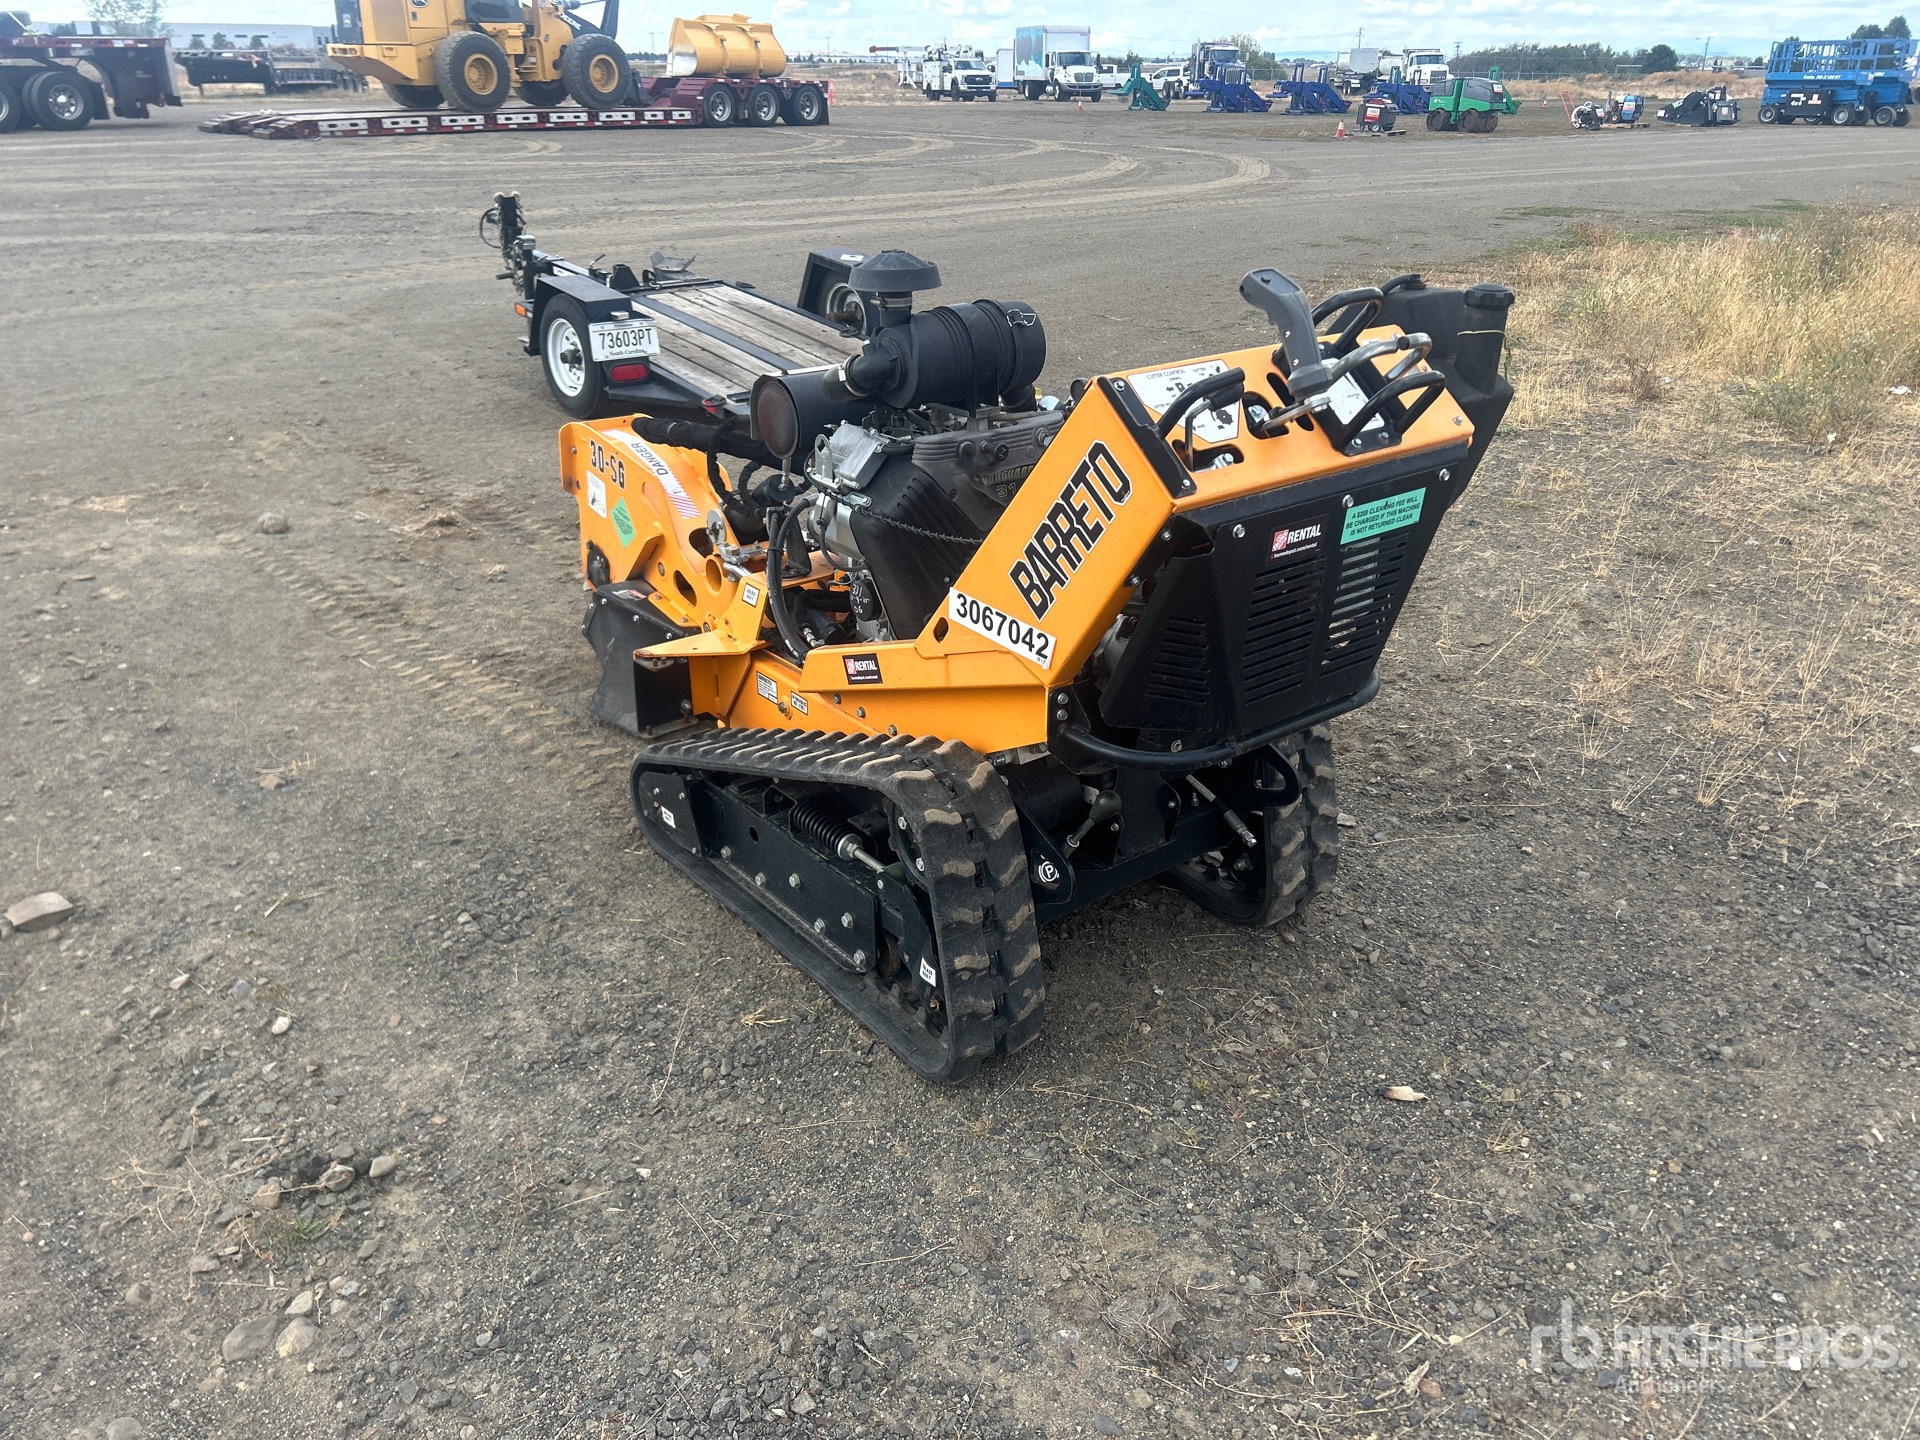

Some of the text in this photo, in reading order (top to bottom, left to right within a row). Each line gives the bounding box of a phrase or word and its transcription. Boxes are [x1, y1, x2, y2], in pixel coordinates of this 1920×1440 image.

[598, 328, 652, 350] 73603PT
[589, 440, 626, 490] 30-SG
[631, 442, 669, 476] DANGER
[1395, 499, 1406, 507] FEE
[1406, 496, 1418, 504] WILL
[1354, 515, 1380, 527] CHARGED
[1386, 509, 1398, 518] THIS
[1398, 503, 1421, 515] MACHINE
[1356, 526, 1368, 535] NOT
[1368, 518, 1396, 531] RETURNED
[1396, 513, 1414, 523] CLEAN
[1008, 440, 1133, 621] BARRETO
[1286, 523, 1322, 545] RENTAL
[956, 593, 1050, 660] 3067042
[854, 659, 878, 671] RENTAL
